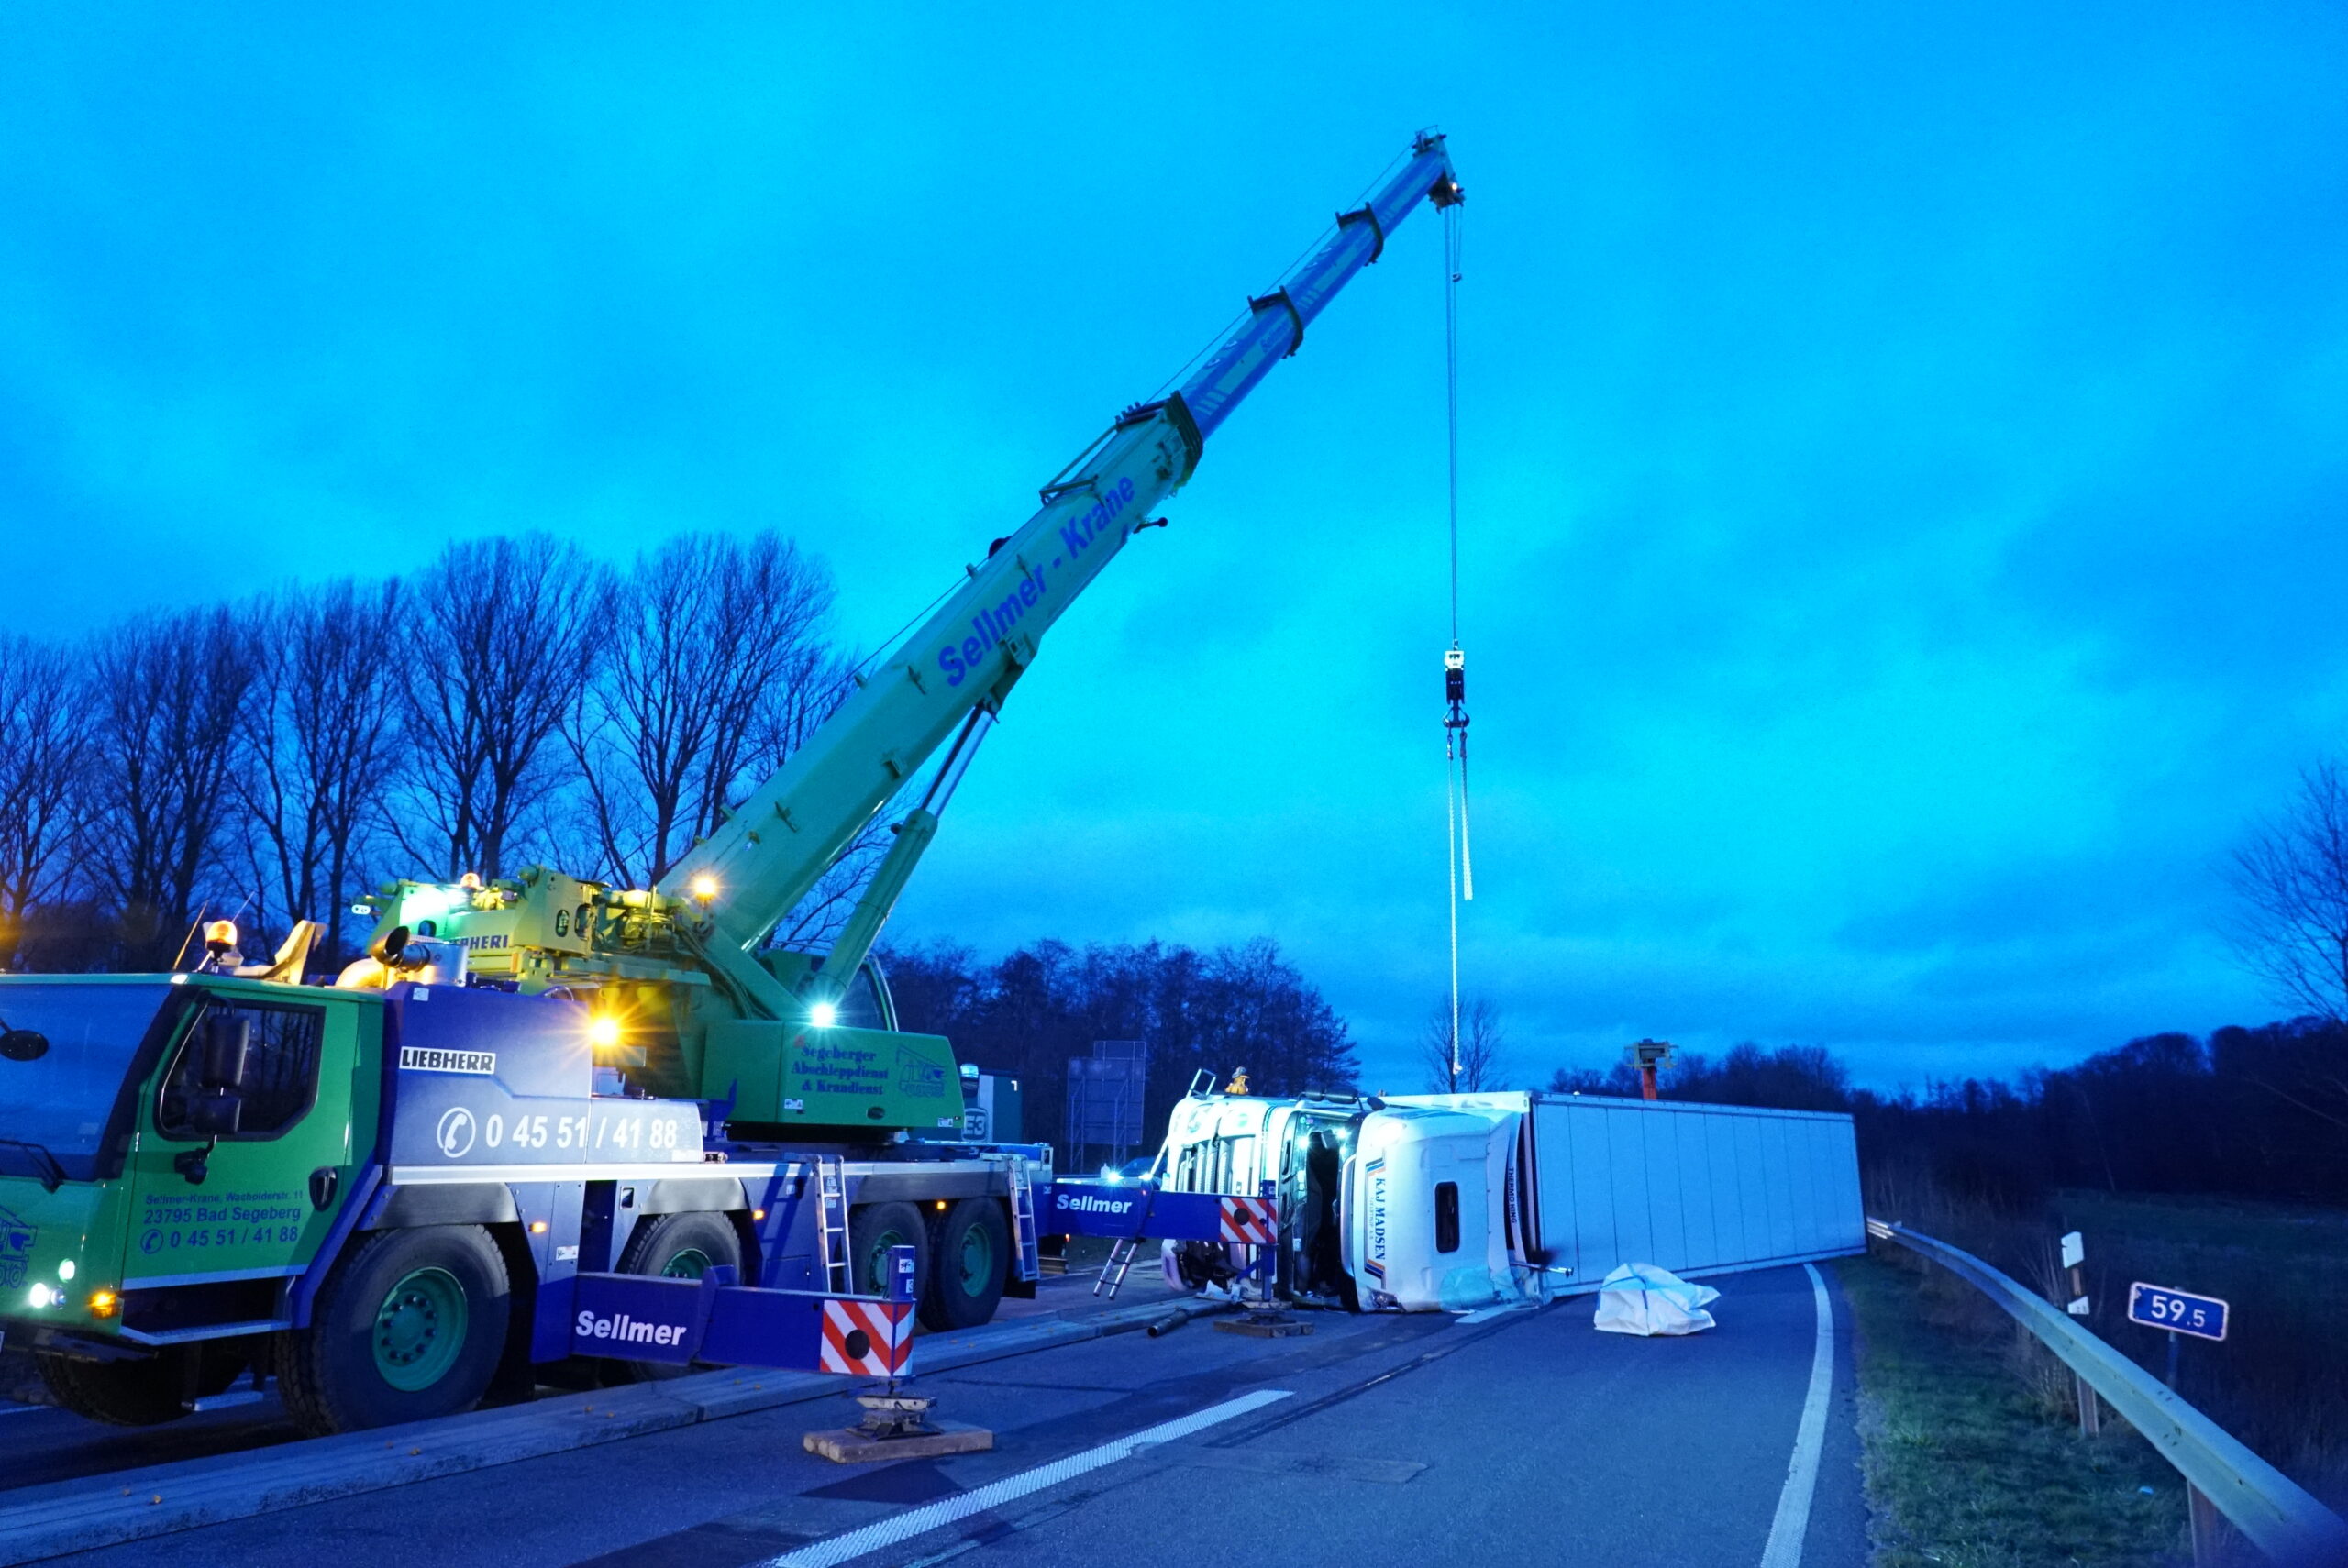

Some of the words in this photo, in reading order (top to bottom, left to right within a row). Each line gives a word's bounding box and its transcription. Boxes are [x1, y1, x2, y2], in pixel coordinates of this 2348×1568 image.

[938, 563, 1047, 687] Sellmer
[1059, 476, 1135, 560] Krane
[401, 1048, 493, 1071] LIEBHERR
[816, 1079, 884, 1096] Krandienst
[484, 1114, 504, 1148] 0
[512, 1114, 548, 1148] 45
[556, 1115, 588, 1148] 51
[595, 1116, 608, 1148] /
[612, 1116, 640, 1148] 41
[649, 1119, 678, 1148] 88
[1375, 1177, 1386, 1203] KAJ
[1507, 1165, 1515, 1203] THERMO
[143, 1208, 192, 1225] 23795
[196, 1207, 228, 1222] Bad
[231, 1205, 302, 1224] Segeberg
[1056, 1193, 1133, 1214] Sellmer
[1509, 1203, 1518, 1224] KING
[169, 1231, 182, 1248] 0
[186, 1229, 210, 1247] 45
[215, 1228, 236, 1246] 51
[252, 1226, 272, 1244] 41
[278, 1225, 299, 1242] 88
[1375, 1207, 1386, 1261] MADSEN
[2150, 1294, 2207, 1328] 59.5
[575, 1309, 688, 1346] Sellmer
